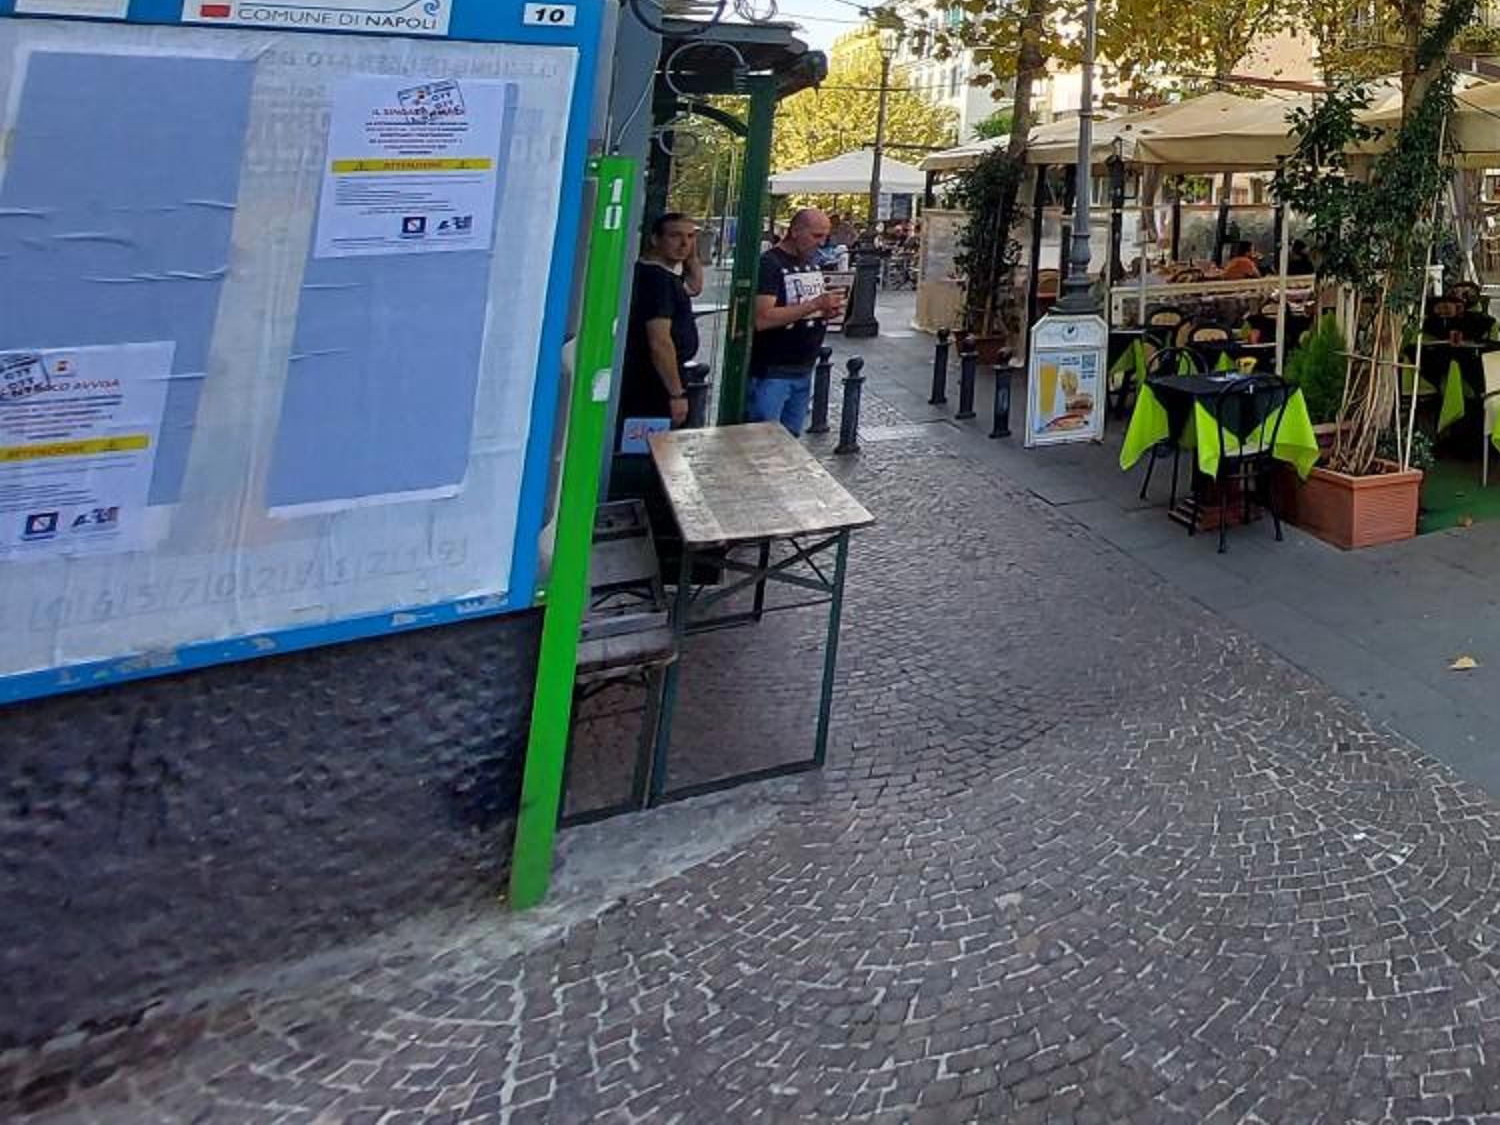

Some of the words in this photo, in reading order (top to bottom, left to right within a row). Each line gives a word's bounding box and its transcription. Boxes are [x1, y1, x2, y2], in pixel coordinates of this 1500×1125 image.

[238, 7, 333, 25] COMUNE
[339, 13, 359, 26] DI
[365, 14, 437, 31] NAPOLI
[534, 8, 565, 23] 10
